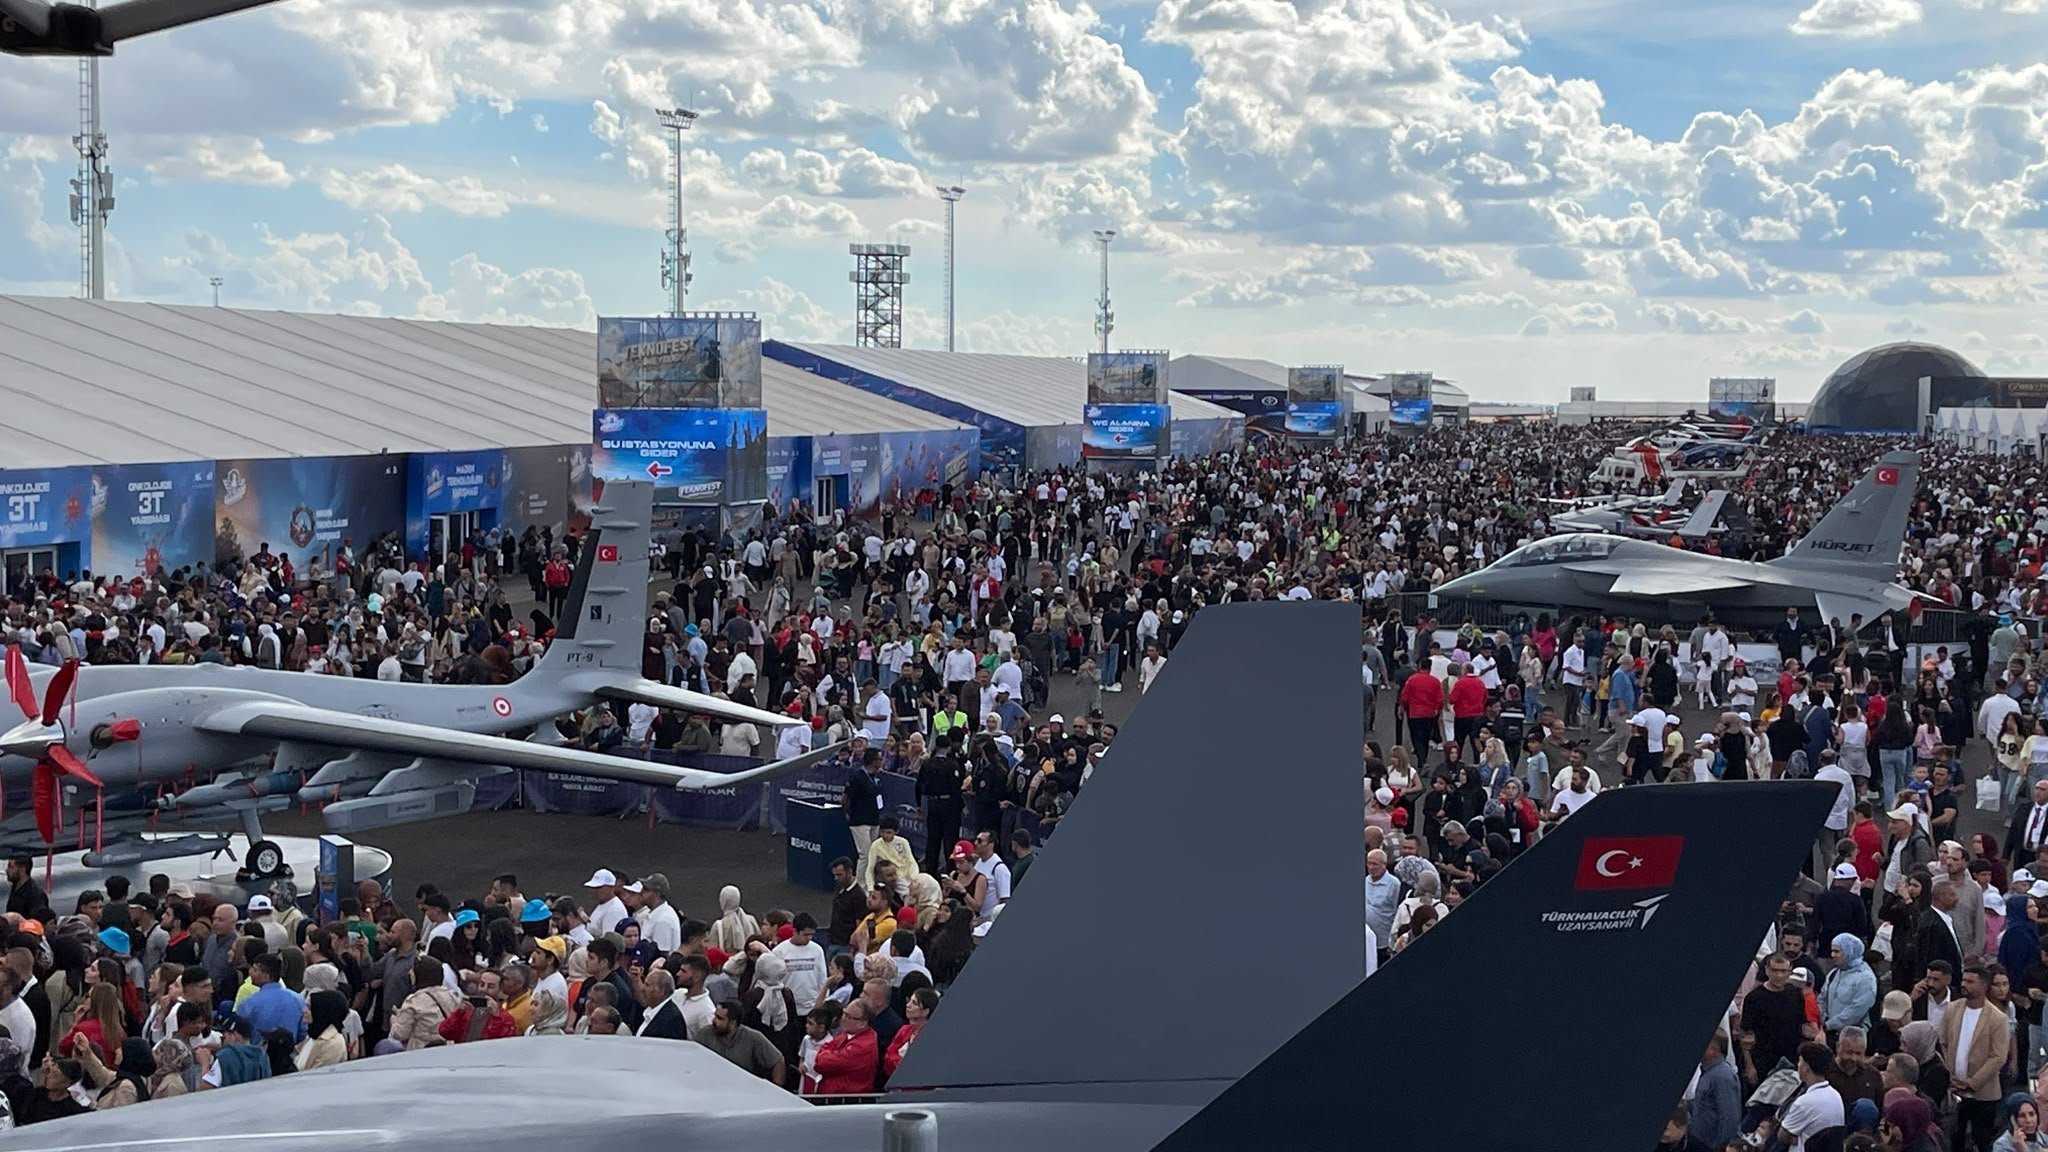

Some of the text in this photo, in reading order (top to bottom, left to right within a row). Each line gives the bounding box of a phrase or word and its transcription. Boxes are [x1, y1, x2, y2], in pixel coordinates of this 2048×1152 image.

[602, 440, 620, 449] SU
[9, 495, 41, 522] 3T
[139, 492, 165, 514] 3T
[1811, 539, 1875, 552] HÜRJET
[567, 653, 594, 663] PT-9
